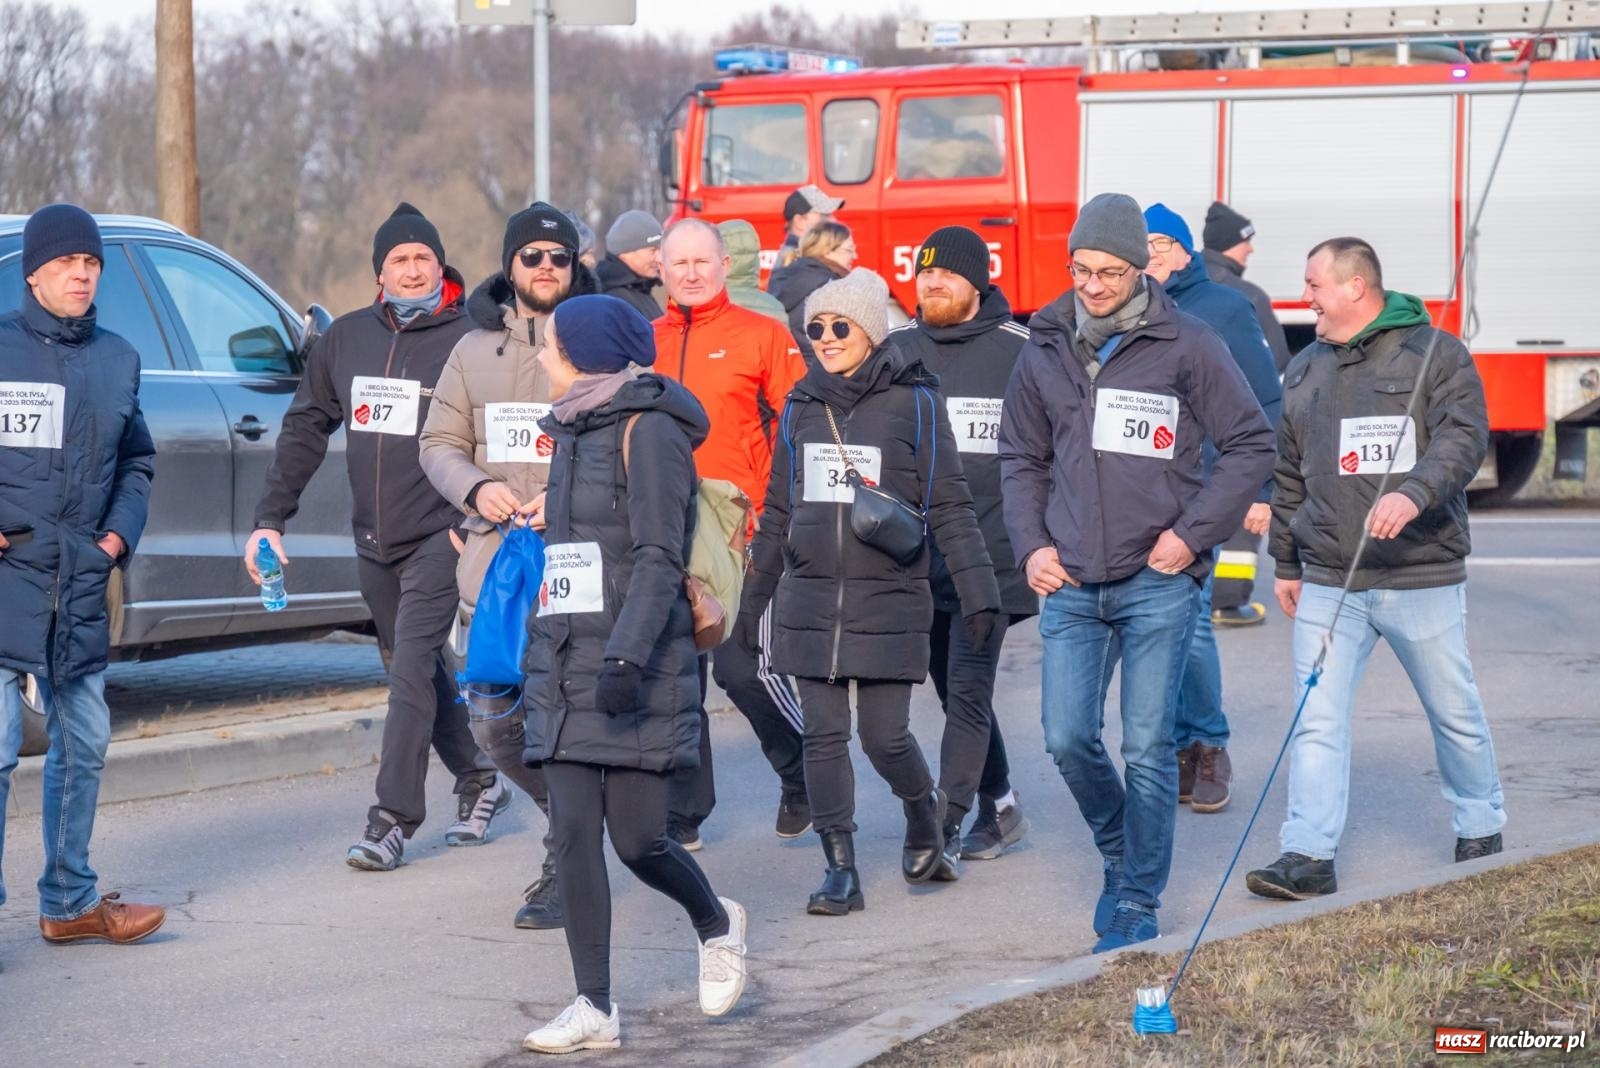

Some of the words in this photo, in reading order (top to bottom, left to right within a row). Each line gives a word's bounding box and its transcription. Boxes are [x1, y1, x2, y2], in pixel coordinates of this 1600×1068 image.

[1119, 395, 1135, 403] BIEG
[1, 413, 42, 433] 137
[372, 404, 393, 422] 87
[507, 428, 531, 448] 30
[967, 421, 1000, 440] 128
[1123, 418, 1150, 440] 50
[1360, 443, 1395, 462] 131
[827, 468, 850, 488] 34
[548, 576, 571, 599] 49
